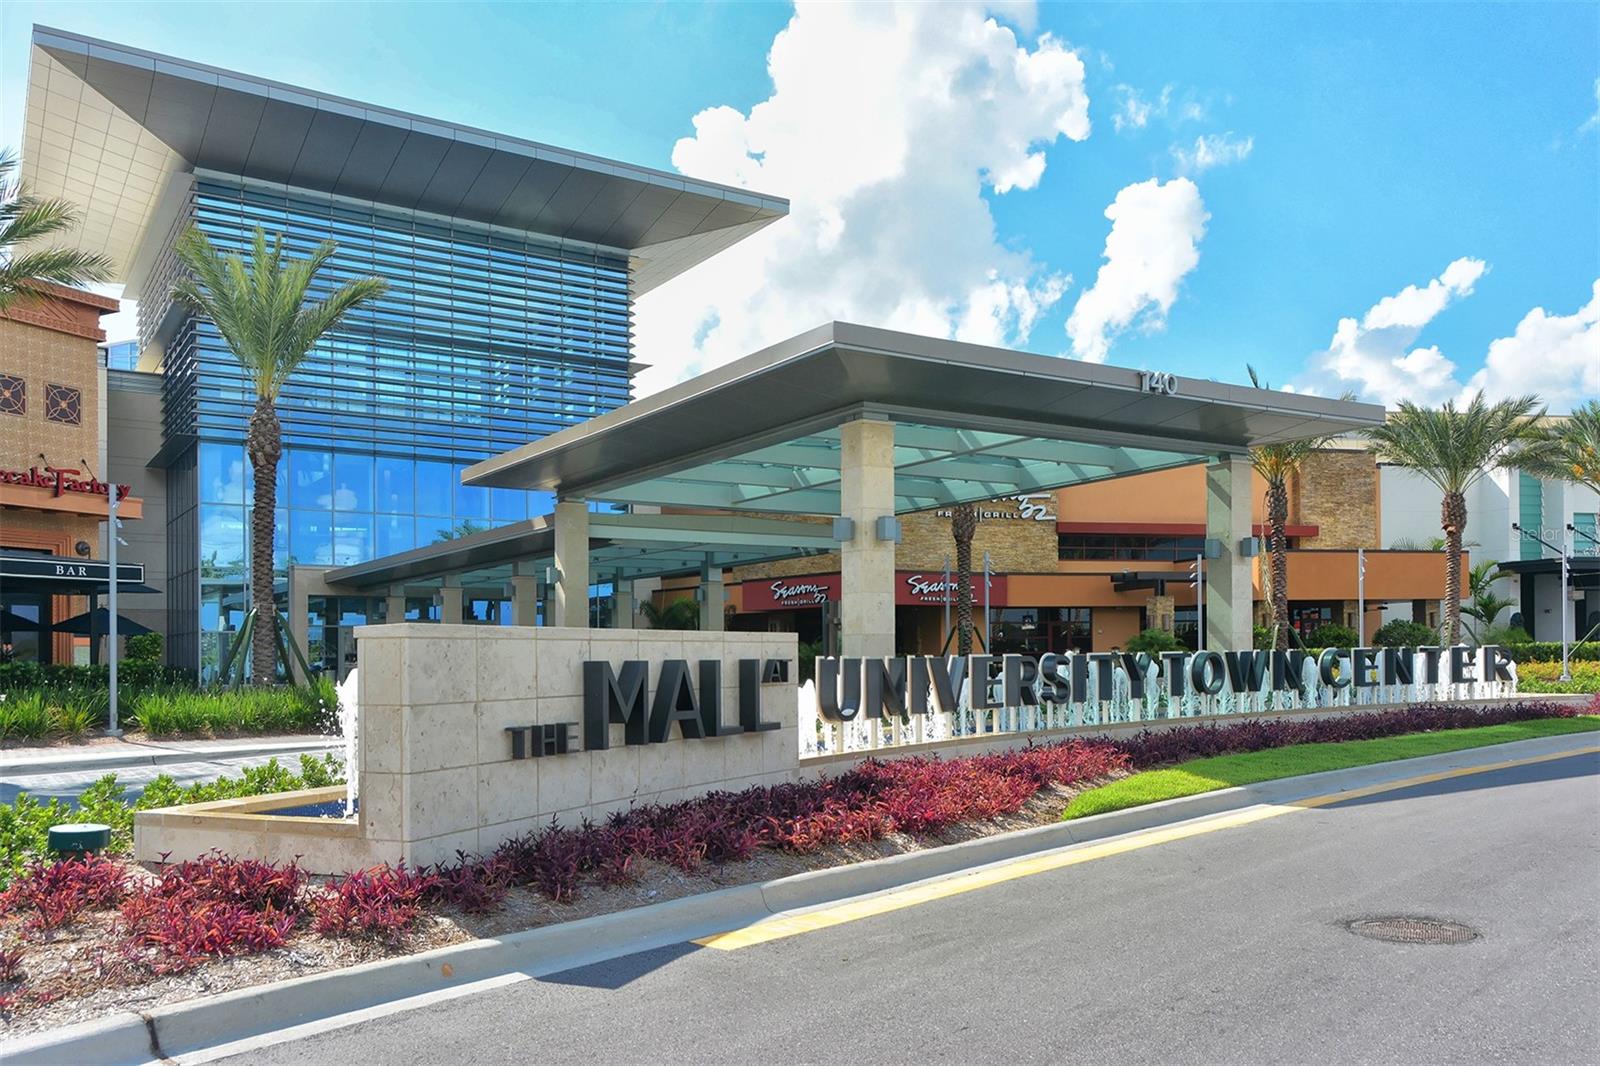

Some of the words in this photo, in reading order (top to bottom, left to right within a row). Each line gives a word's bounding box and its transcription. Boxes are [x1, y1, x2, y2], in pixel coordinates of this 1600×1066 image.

[1138, 370, 1178, 395] 140
[984, 511, 1019, 519] GRILL
[56, 565, 87, 576] BAR
[770, 581, 828, 600] Seasons
[815, 651, 1153, 723] UNIVERSITY
[1159, 648, 1302, 695] TOWN
[1318, 644, 1513, 688] CENTER
[504, 722, 579, 760] THE
[583, 659, 781, 751] MALL
[761, 659, 793, 683] AT
